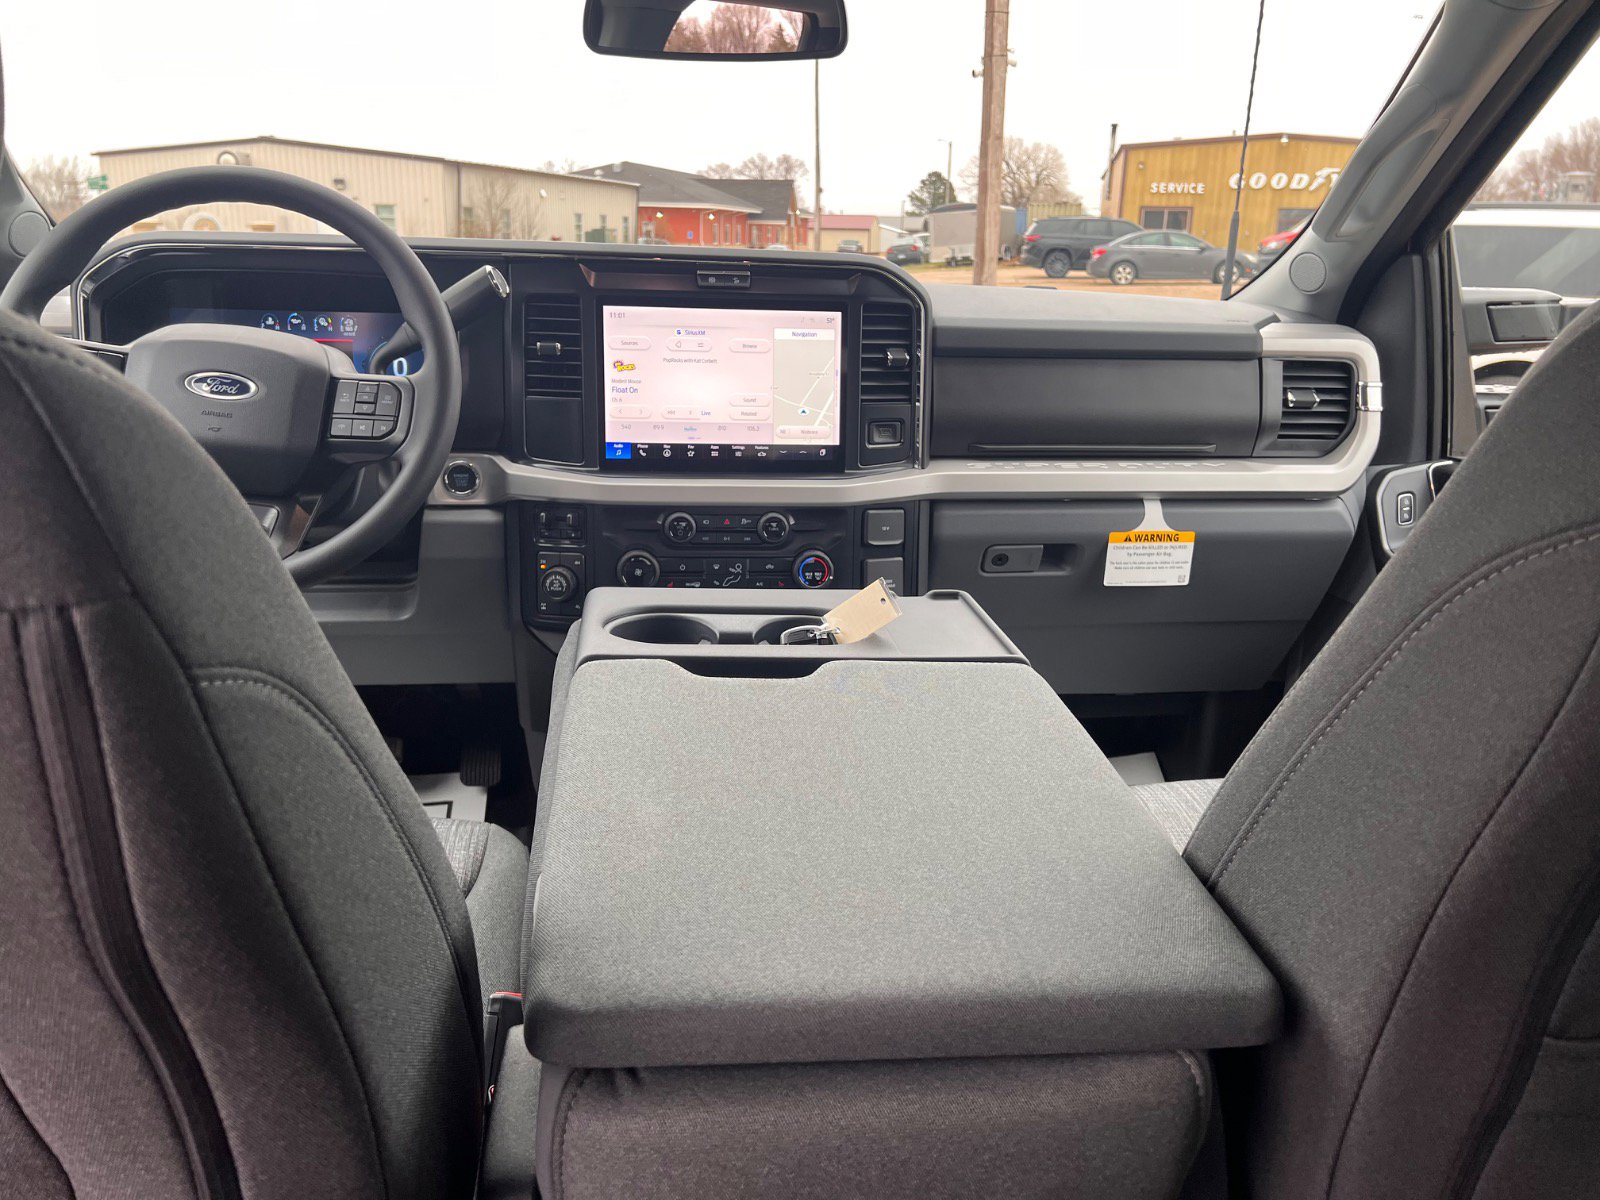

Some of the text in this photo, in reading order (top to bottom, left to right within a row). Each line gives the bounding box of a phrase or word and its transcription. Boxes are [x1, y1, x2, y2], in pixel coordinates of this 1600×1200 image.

[1150, 182, 1206, 194] SERVICE
[684, 329, 706, 337] SiriusXM
[202, 377, 239, 394] Ford
[611, 386, 627, 394] Float
[1134, 533, 1180, 543] WARNING
